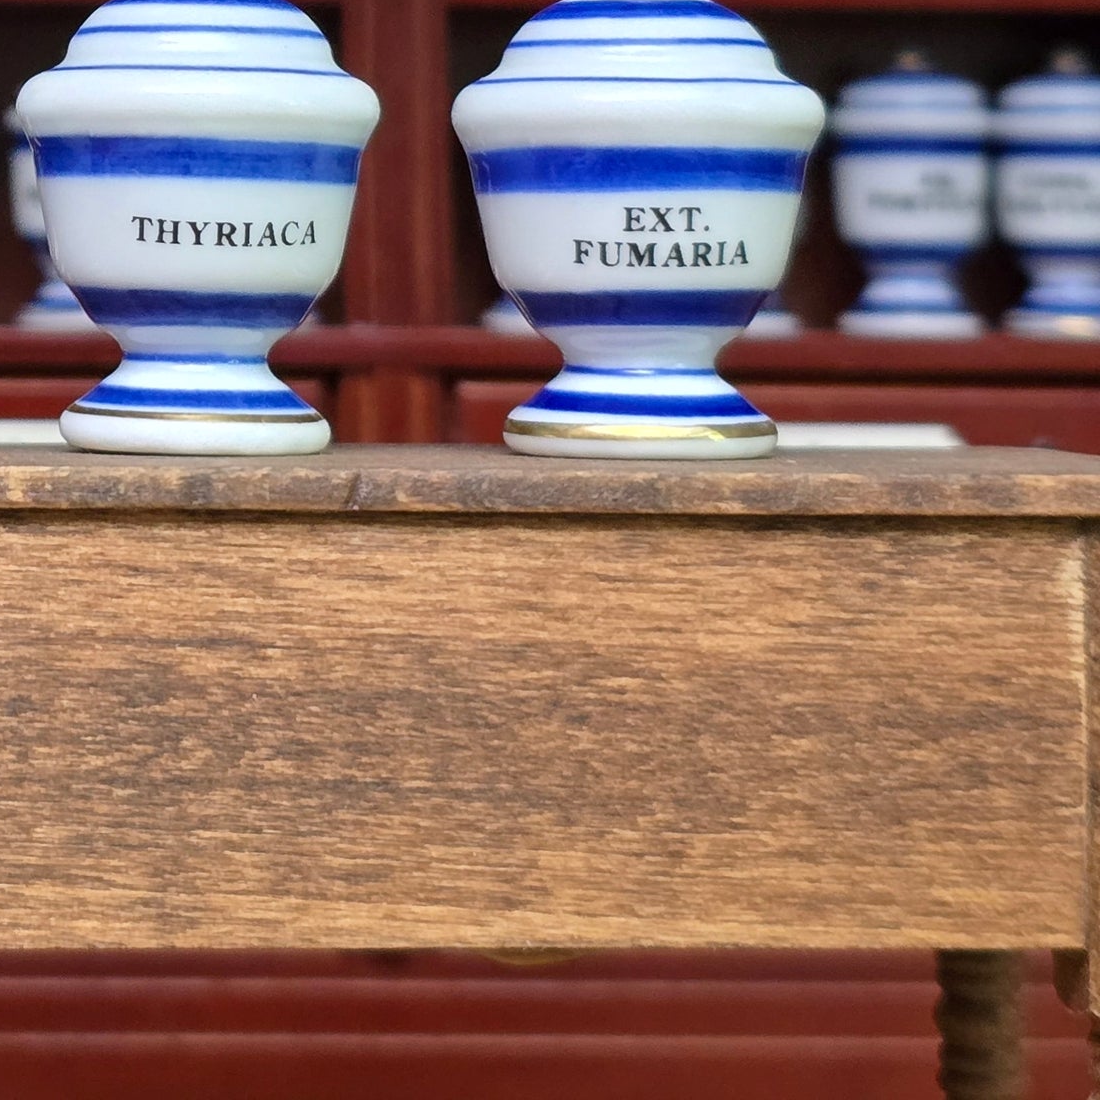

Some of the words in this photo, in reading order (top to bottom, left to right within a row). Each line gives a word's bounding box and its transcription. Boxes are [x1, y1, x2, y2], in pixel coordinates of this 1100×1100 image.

[131, 216, 316, 247] THYRIACA
[623, 207, 710, 233] EXT.
[573, 239, 749, 268] FUMARIA
